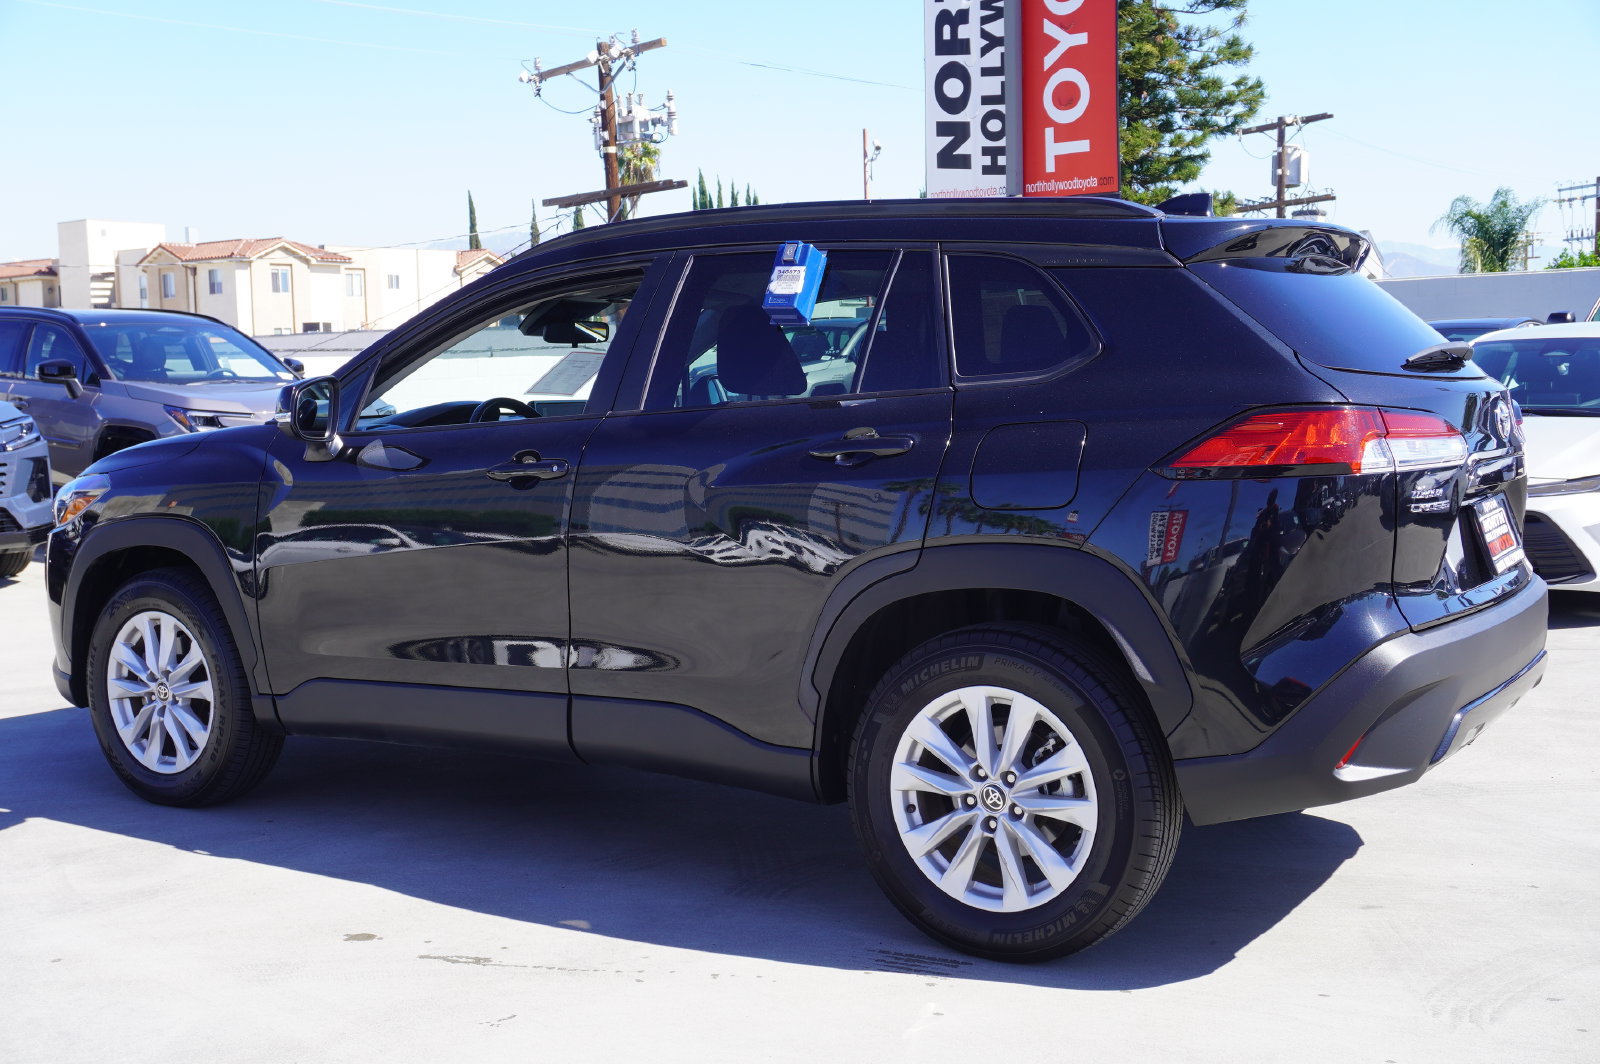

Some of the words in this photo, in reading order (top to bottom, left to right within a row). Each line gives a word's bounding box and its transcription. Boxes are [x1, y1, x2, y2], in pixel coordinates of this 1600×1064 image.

[934, 0, 972, 170] NOR
[1043, 0, 1091, 174] TOY
[1025, 175, 1115, 194] northhollywoodtoyota.com
[901, 655, 980, 696] MICHELIN
[994, 656, 1041, 679] PRIMACY
[991, 911, 1078, 945] MICHELIN
